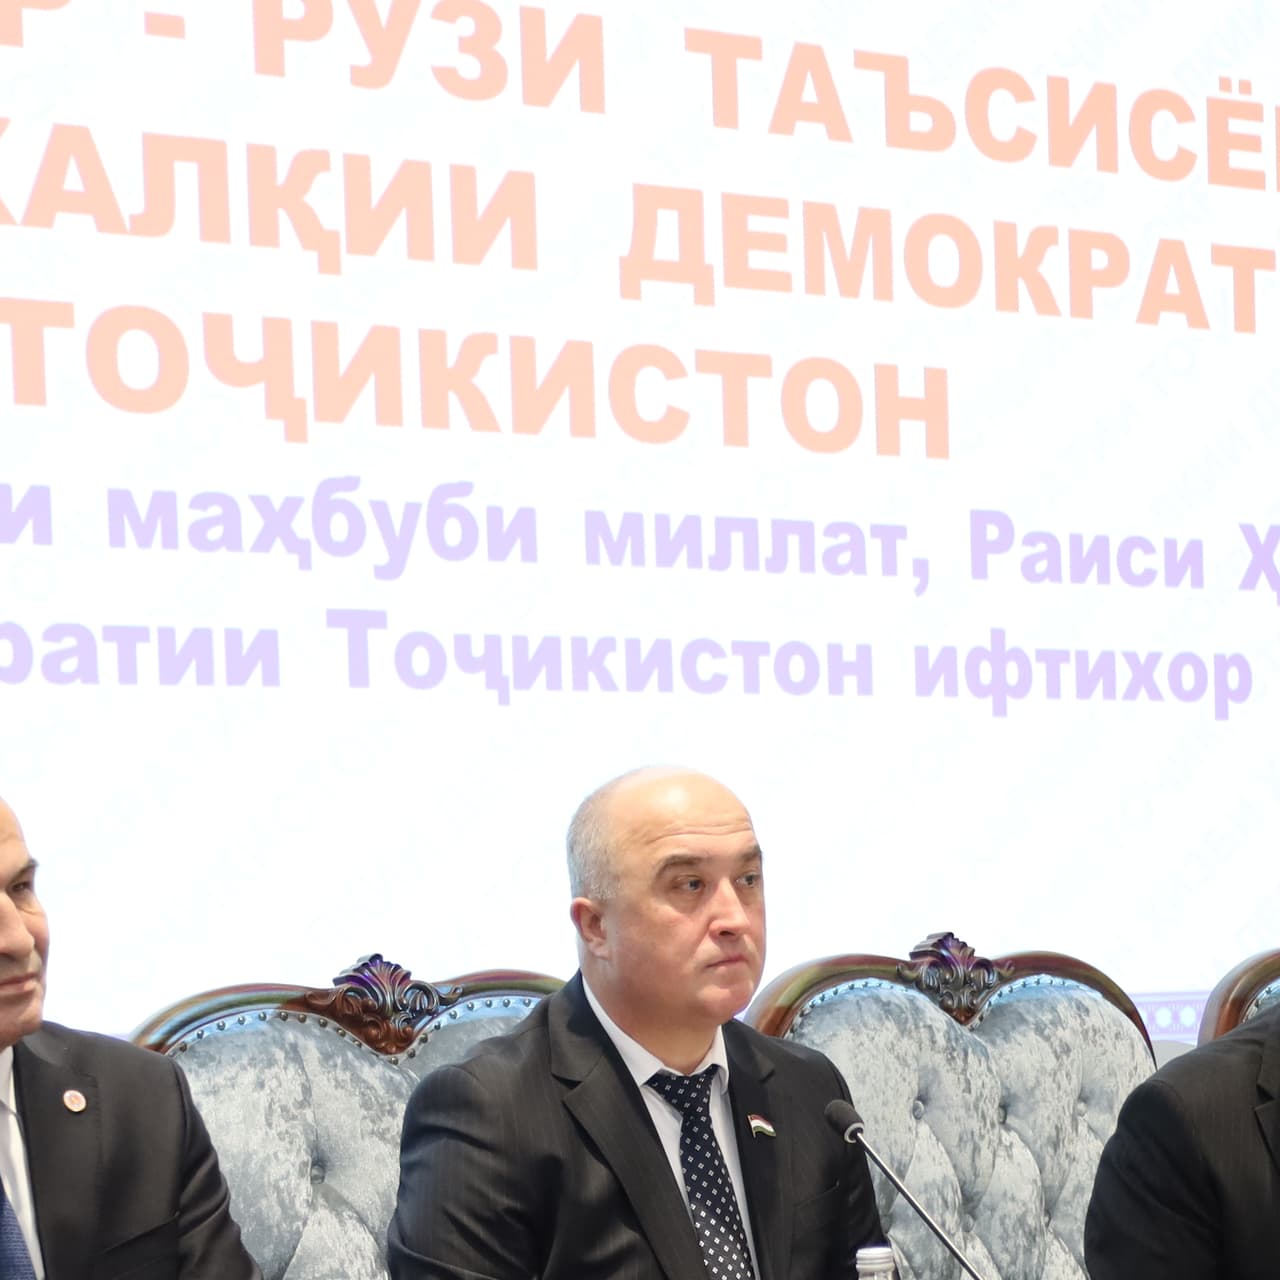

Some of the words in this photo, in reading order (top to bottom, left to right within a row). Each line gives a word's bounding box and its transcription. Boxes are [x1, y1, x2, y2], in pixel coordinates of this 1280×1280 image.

[107, 475, 537, 581] маҳбуби
[585, 510, 929, 596] миллат,
[970, 509, 1204, 589] Раиси
[326, 608, 873, 706] Тоҷикистон
[914, 628, 1253, 720] ифтихор
